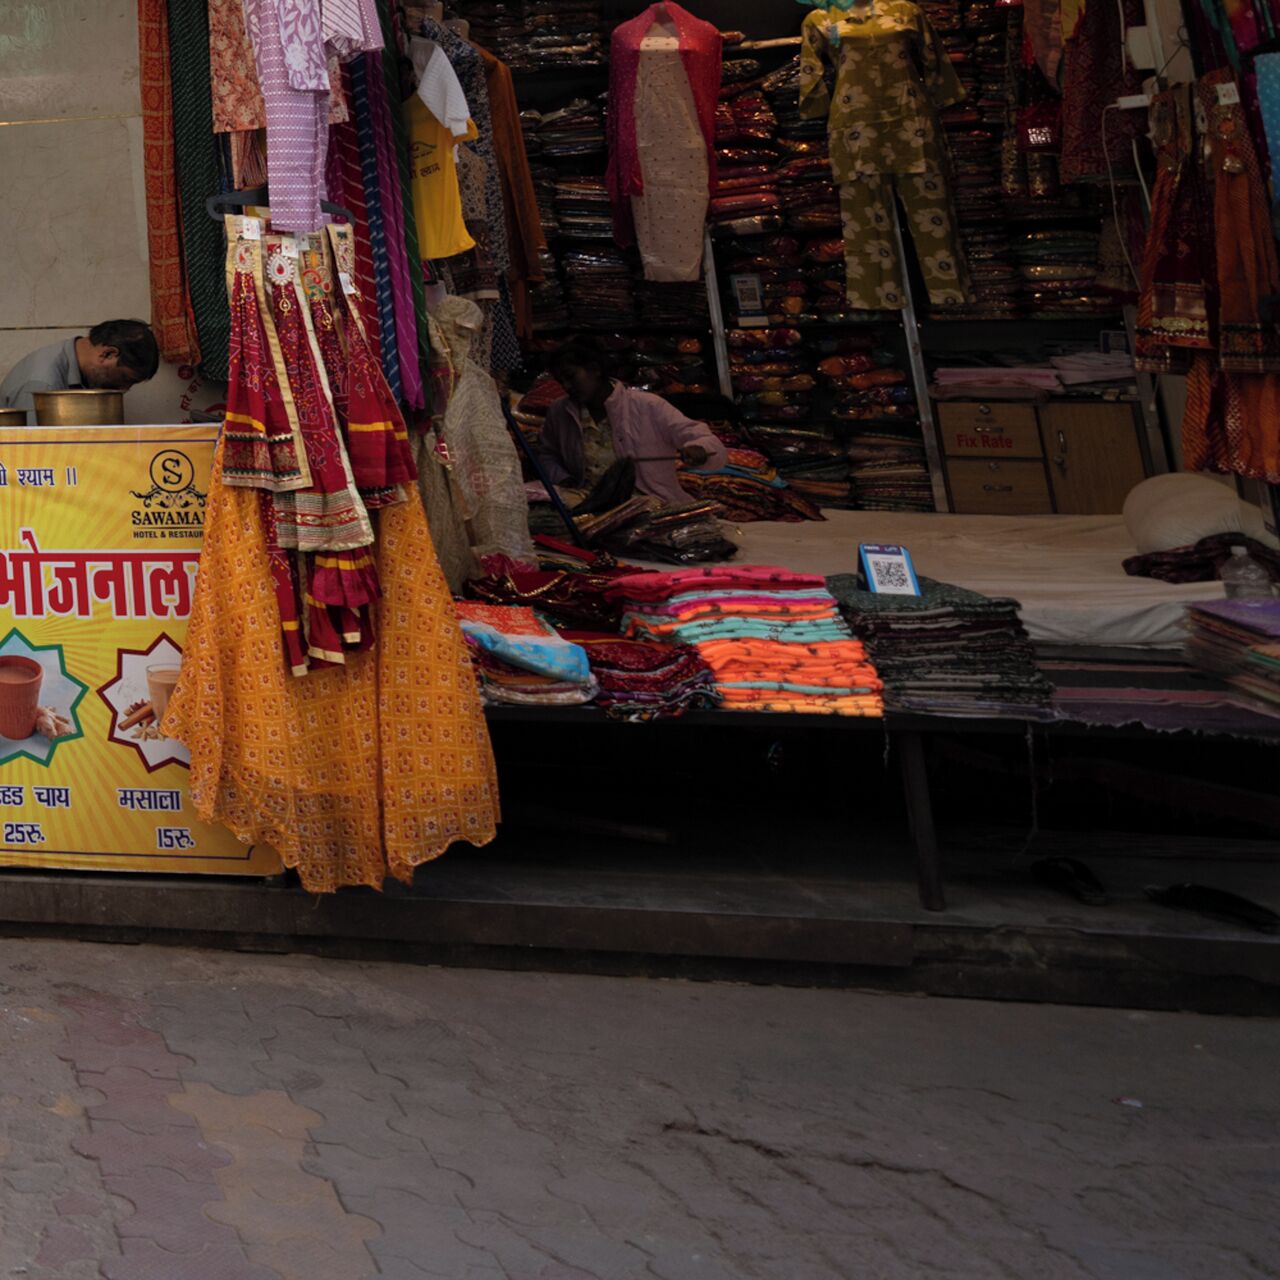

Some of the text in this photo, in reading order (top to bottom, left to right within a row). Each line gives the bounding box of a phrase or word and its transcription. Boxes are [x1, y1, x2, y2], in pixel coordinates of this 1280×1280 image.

[955, 433, 1014, 449] Fix Rate
[17, 466, 57, 488] श्याम
[132, 529, 206, 540] HOTEL & RESTAUR
[33, 785, 71, 808] चाय
[118, 787, 182, 811] मसाला
[3, 822, 46, 844] 25रु.
